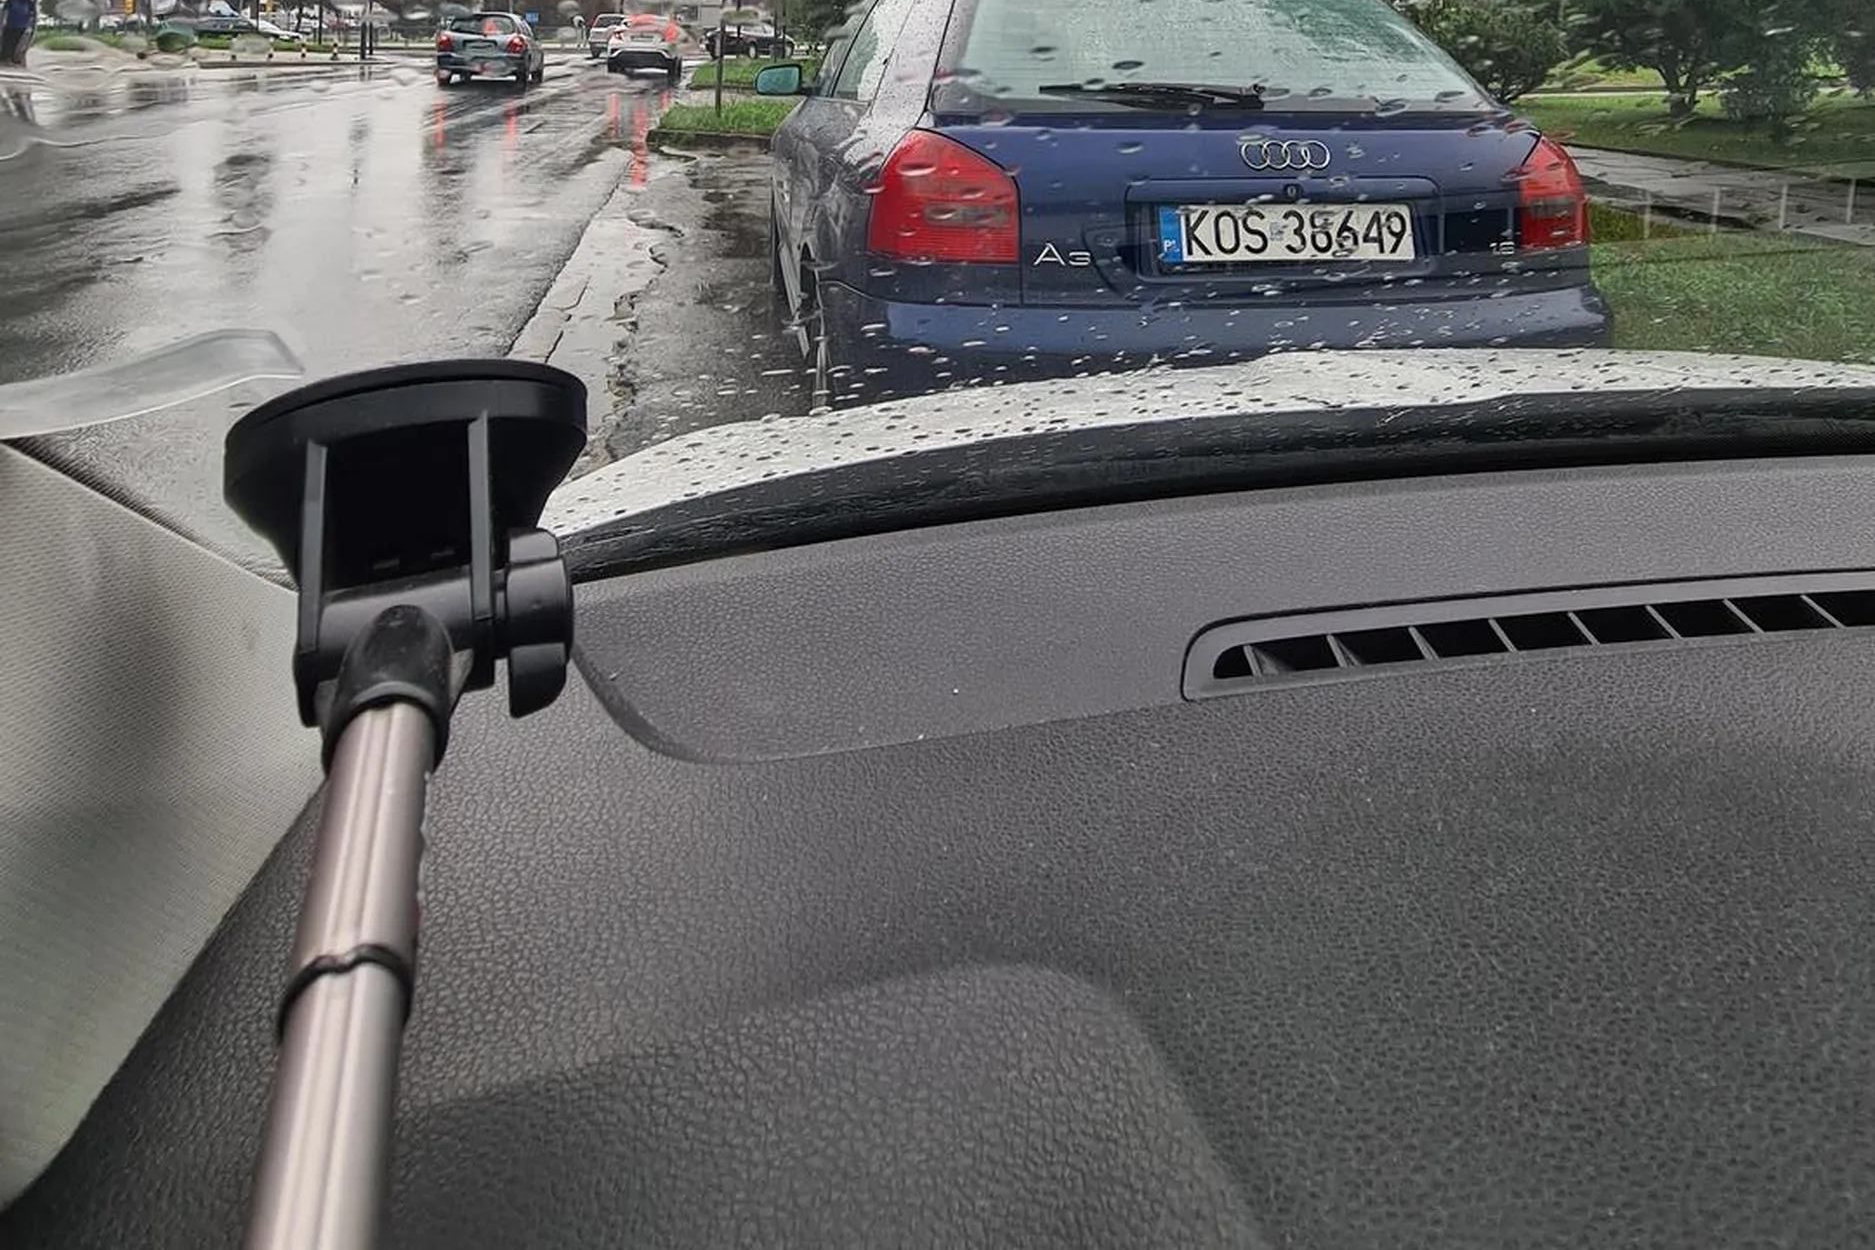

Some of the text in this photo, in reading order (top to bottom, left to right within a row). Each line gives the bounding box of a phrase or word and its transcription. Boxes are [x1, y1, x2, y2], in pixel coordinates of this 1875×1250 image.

[1185, 209, 1407, 256] KOS 38649
[1033, 241, 1091, 266] A3
